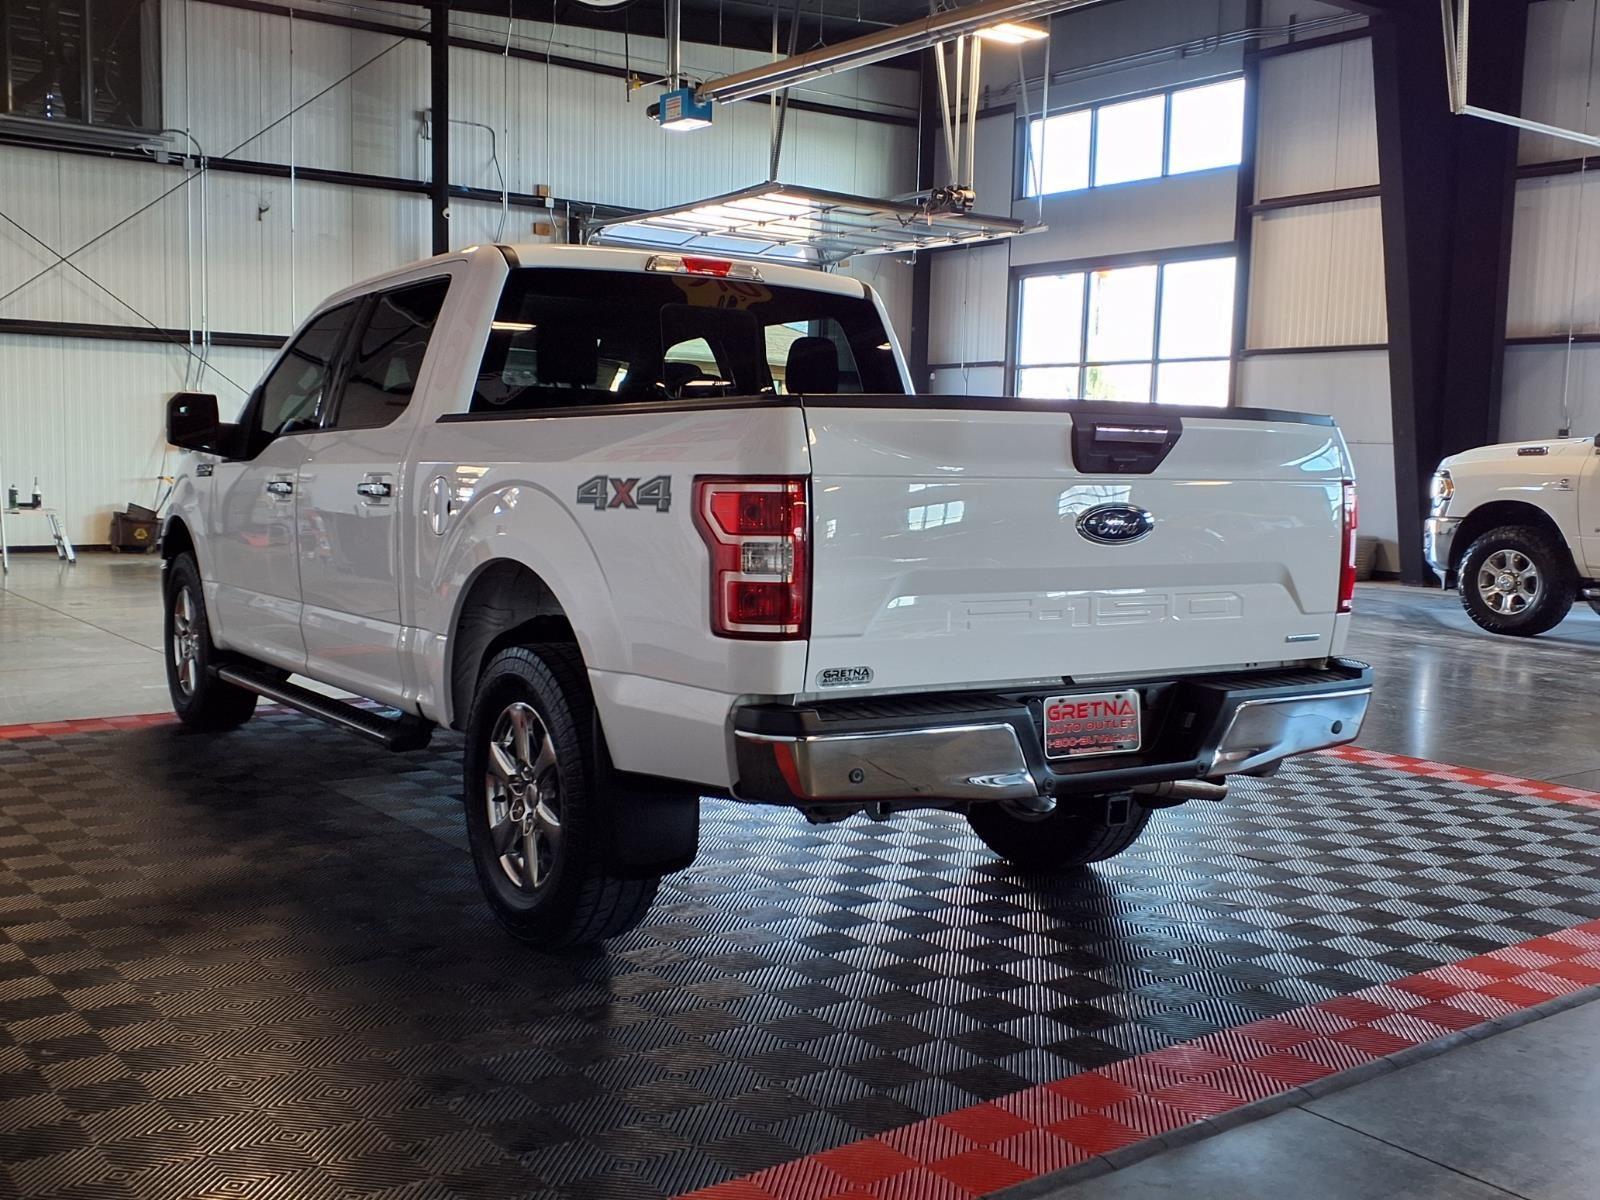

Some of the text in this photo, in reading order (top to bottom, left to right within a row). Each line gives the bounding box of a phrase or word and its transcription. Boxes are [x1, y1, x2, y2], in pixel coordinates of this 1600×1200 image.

[1096, 511, 1141, 536] Ford
[823, 668, 870, 678] GRETNA
[1047, 700, 1136, 721] GRETNA
[1047, 719, 1137, 734] AUTO OUTLET
